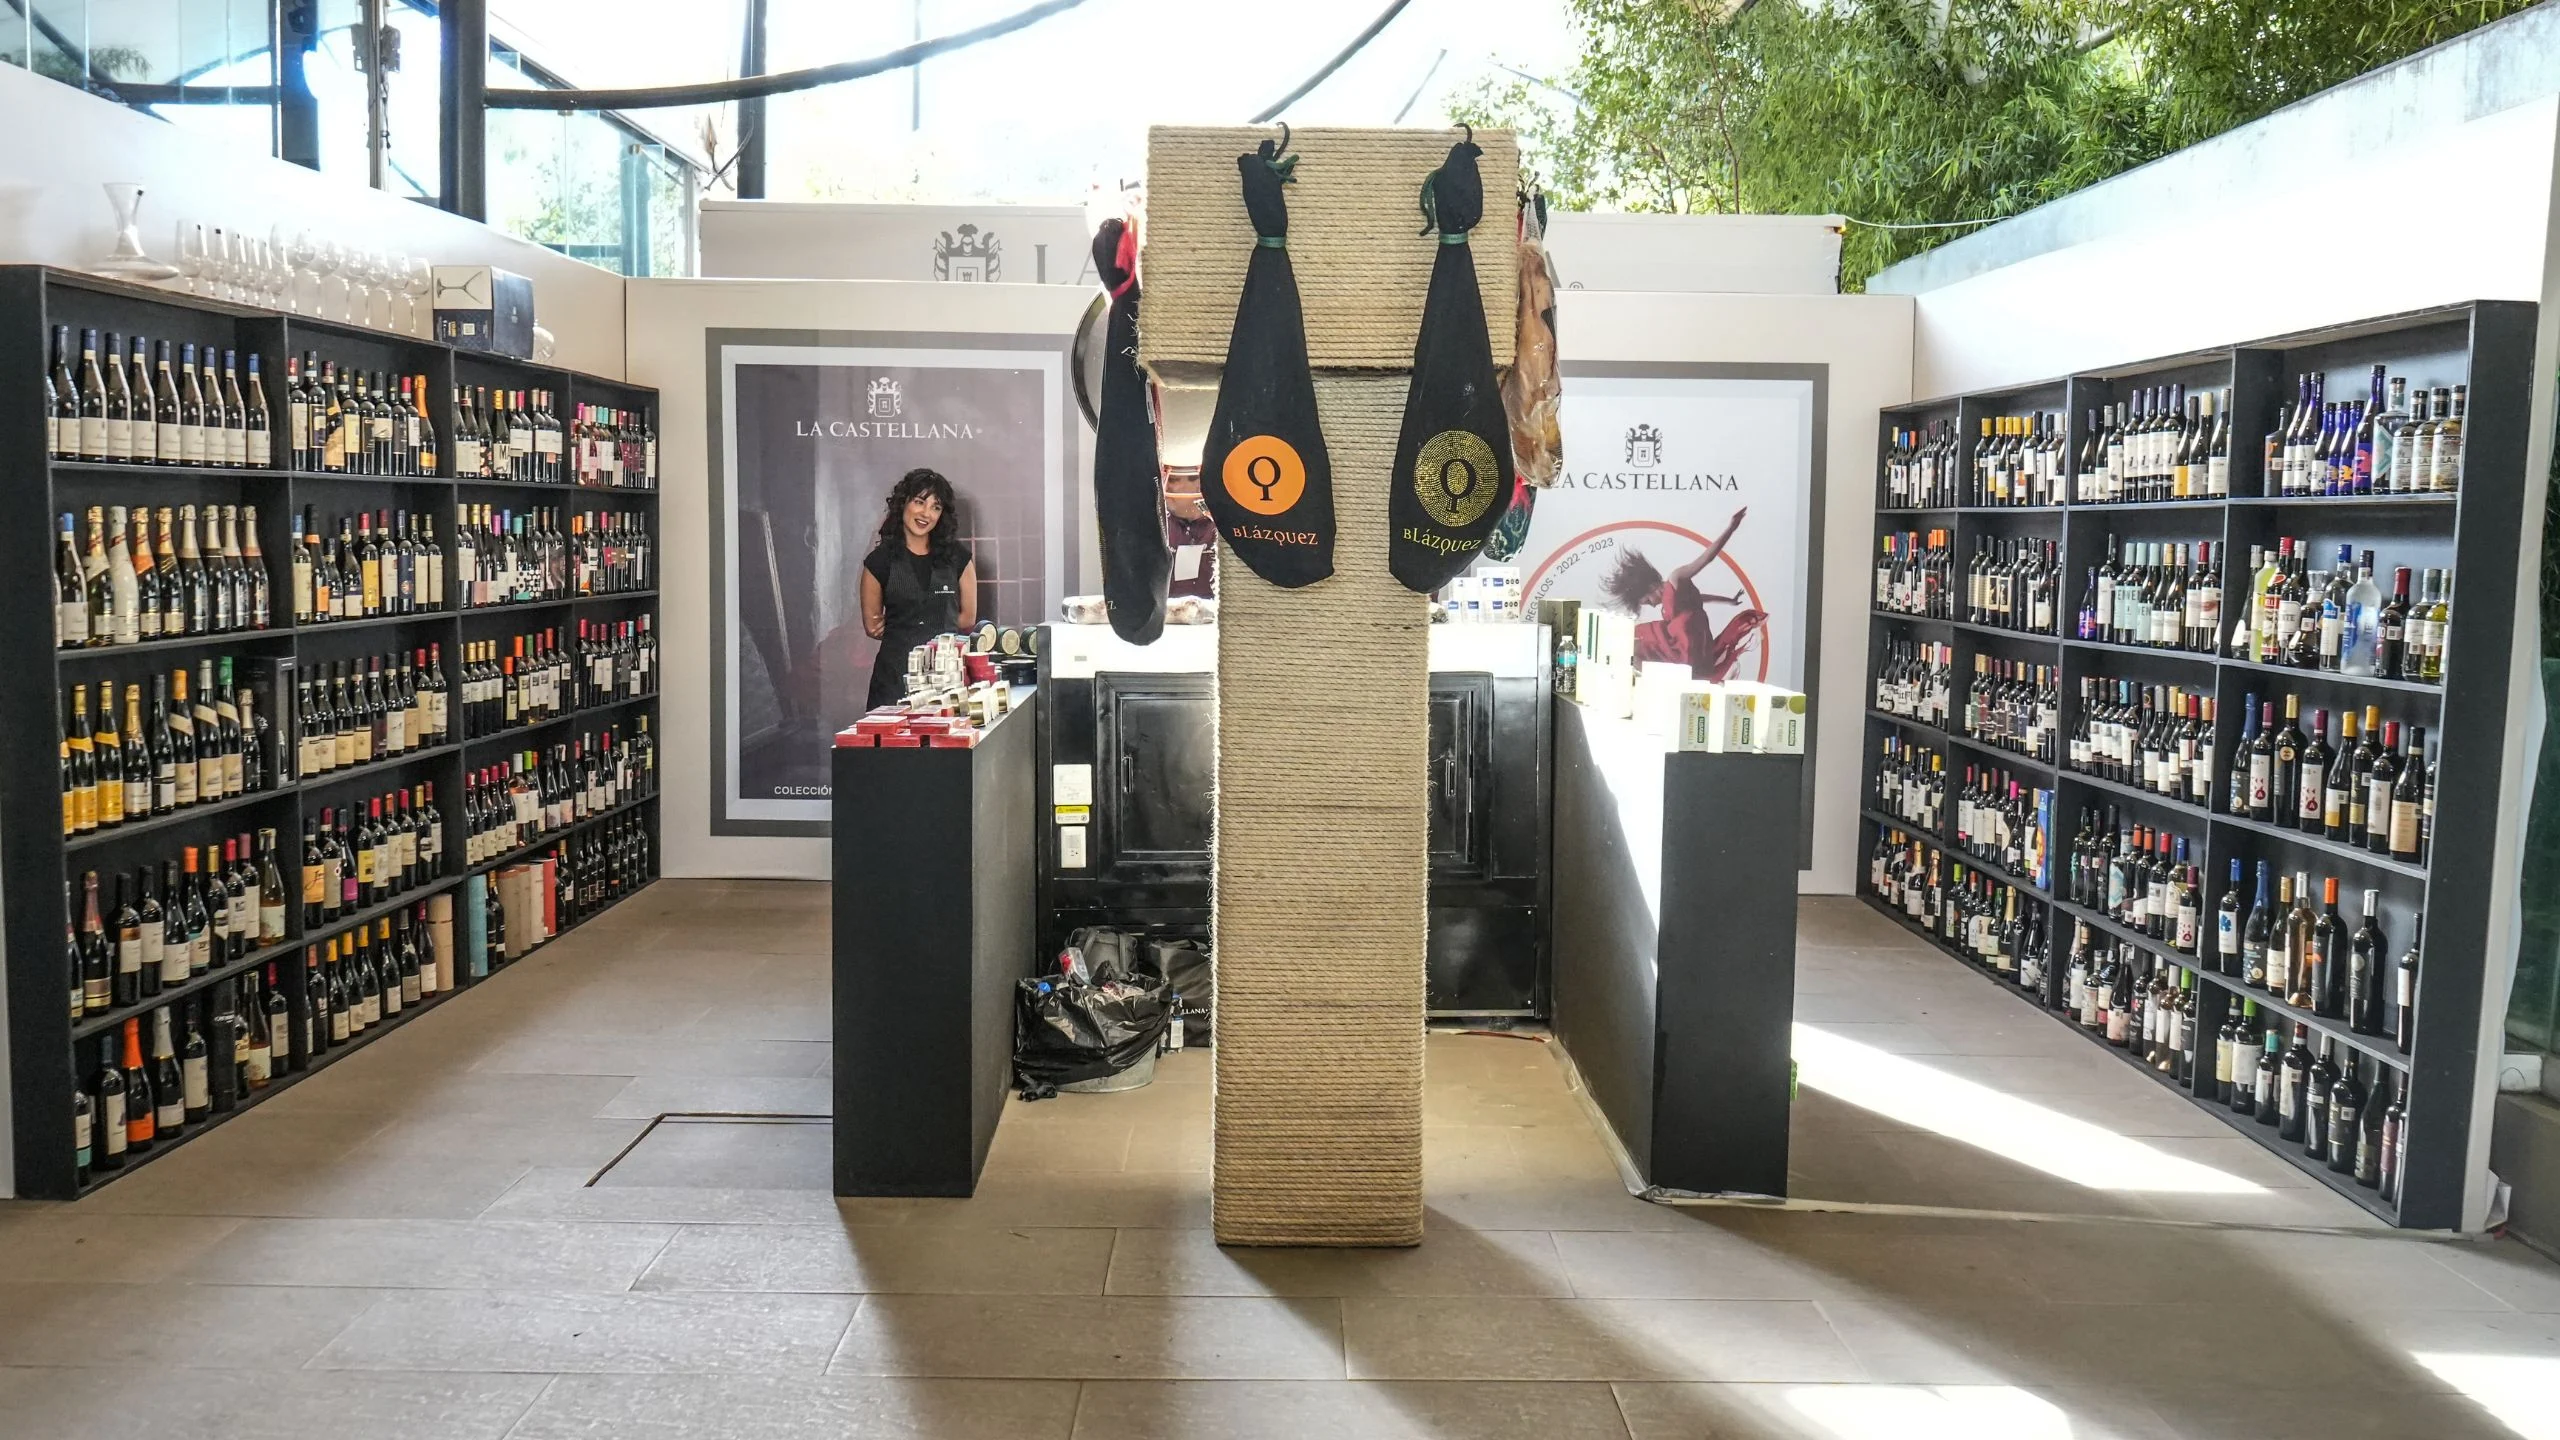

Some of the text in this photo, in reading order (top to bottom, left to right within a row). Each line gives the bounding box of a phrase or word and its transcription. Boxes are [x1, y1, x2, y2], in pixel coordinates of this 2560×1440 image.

[796, 420, 974, 439] LA CASTELLANA
[1551, 472, 1739, 491] A CASTELLANA
[1525, 578, 1554, 622] REGALOS
[1556, 552, 1581, 574] 2022
[1588, 537, 1614, 553] 2023
